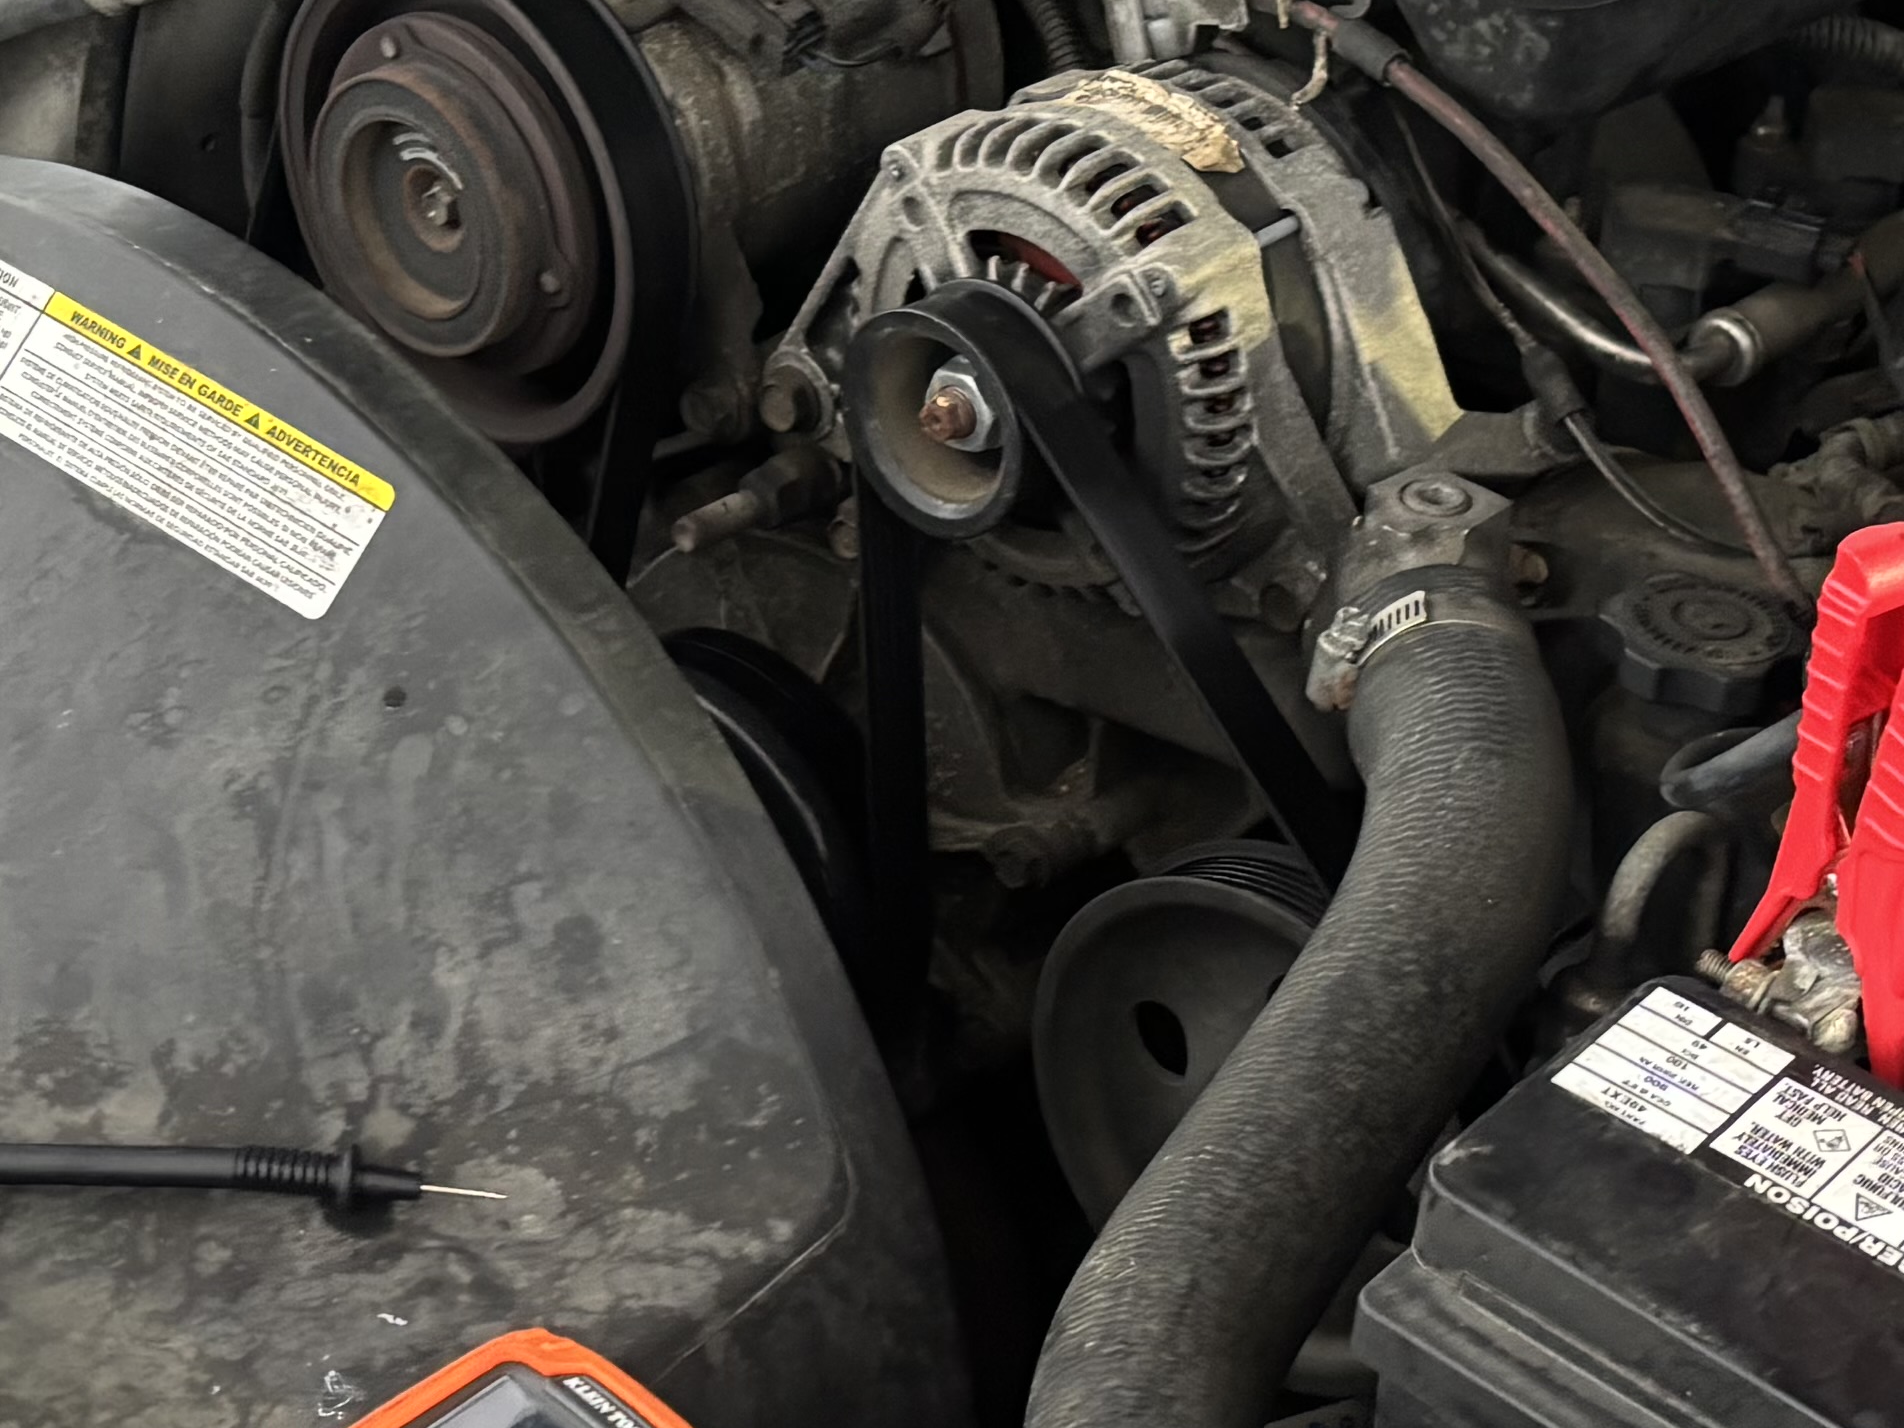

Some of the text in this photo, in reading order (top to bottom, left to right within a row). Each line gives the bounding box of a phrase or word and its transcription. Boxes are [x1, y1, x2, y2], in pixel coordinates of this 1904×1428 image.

[70, 310, 359, 485] WARNING MISE EN GARDE ADVERTENCIA
[1810, 1076, 1836, 1094] ALL
[1812, 1064, 1873, 1102] BATTERY.
[1773, 1090, 1826, 1125] MEDICAL
[1812, 1102, 1847, 1122] HELP
[1834, 1088, 1874, 1115] READ
[1733, 1144, 1807, 1187] FLUSH EYES
[1734, 1132, 1816, 1178] IMMEDIATELY
[1792, 1146, 1825, 1169] WITH
[562, 1376, 616, 1414] KLEIN
